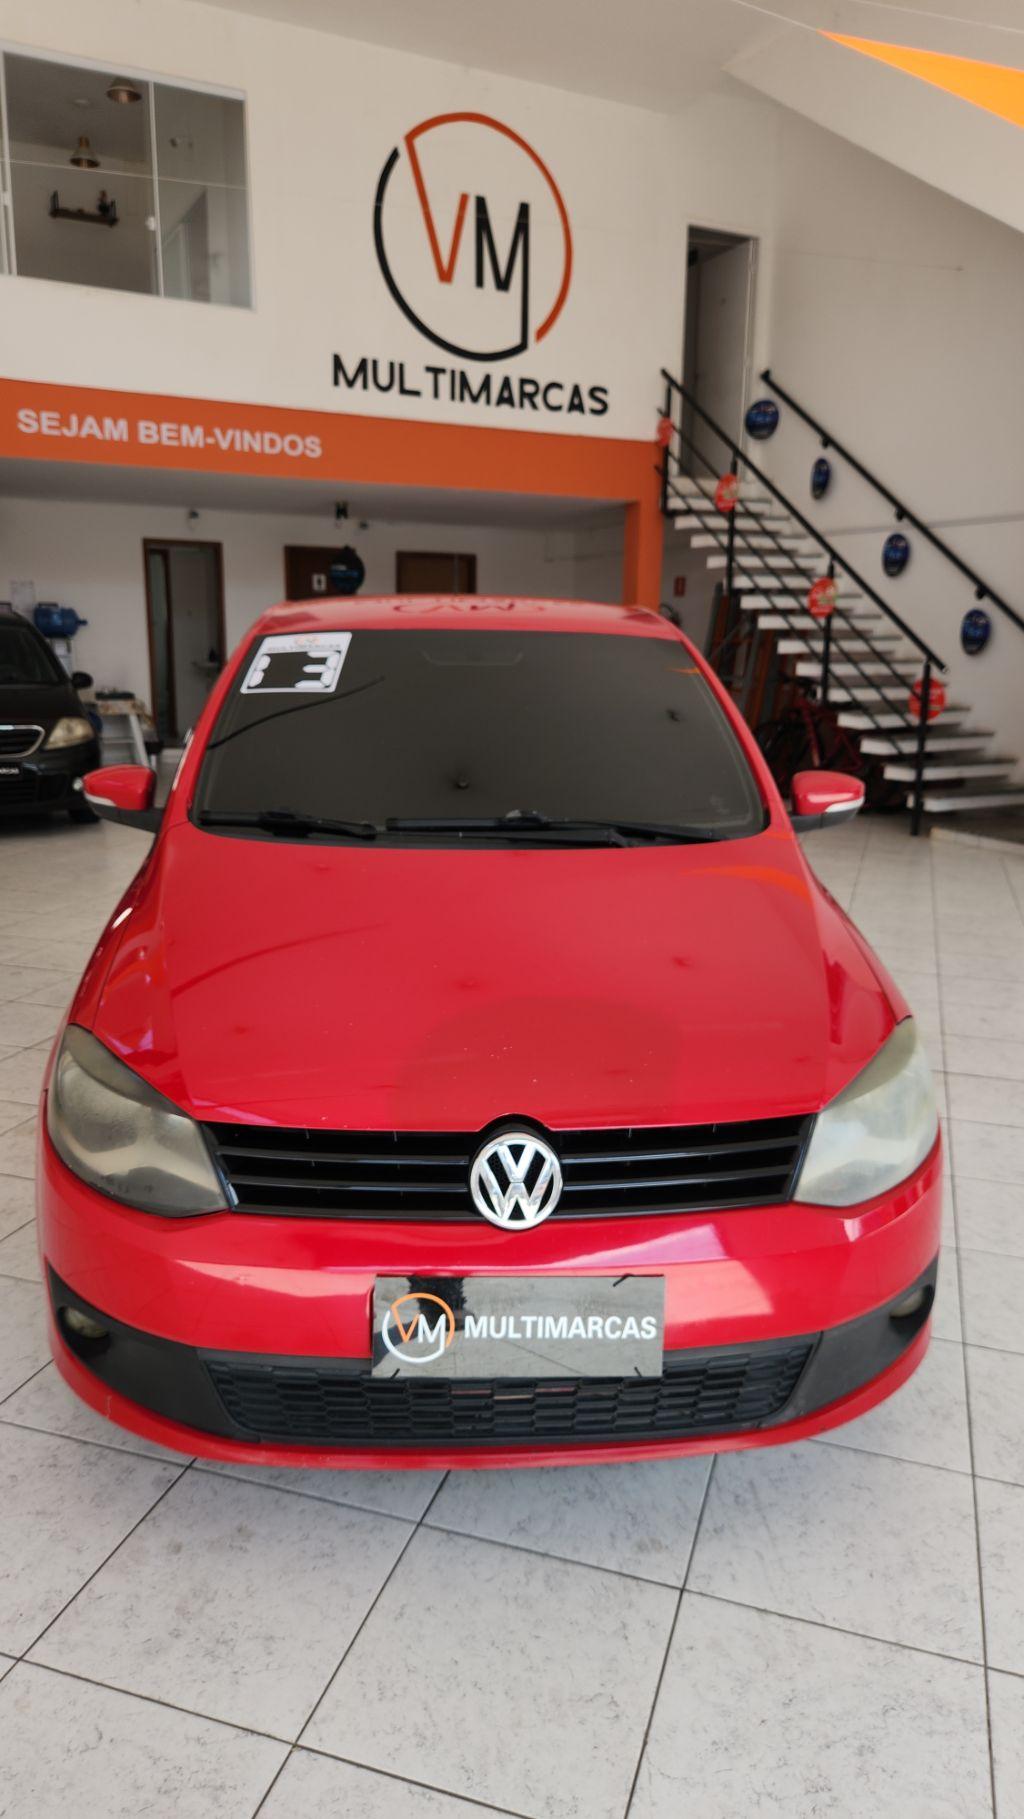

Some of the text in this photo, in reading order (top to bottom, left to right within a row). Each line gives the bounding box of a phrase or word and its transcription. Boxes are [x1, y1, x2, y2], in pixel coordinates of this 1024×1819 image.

[332, 353, 609, 416] MULTIMARCAS
[17, 408, 323, 458] SEJAM BEM-VINDOS
[475, 1137, 559, 1226] VW
[463, 1314, 658, 1341] MULTIMARCAS
